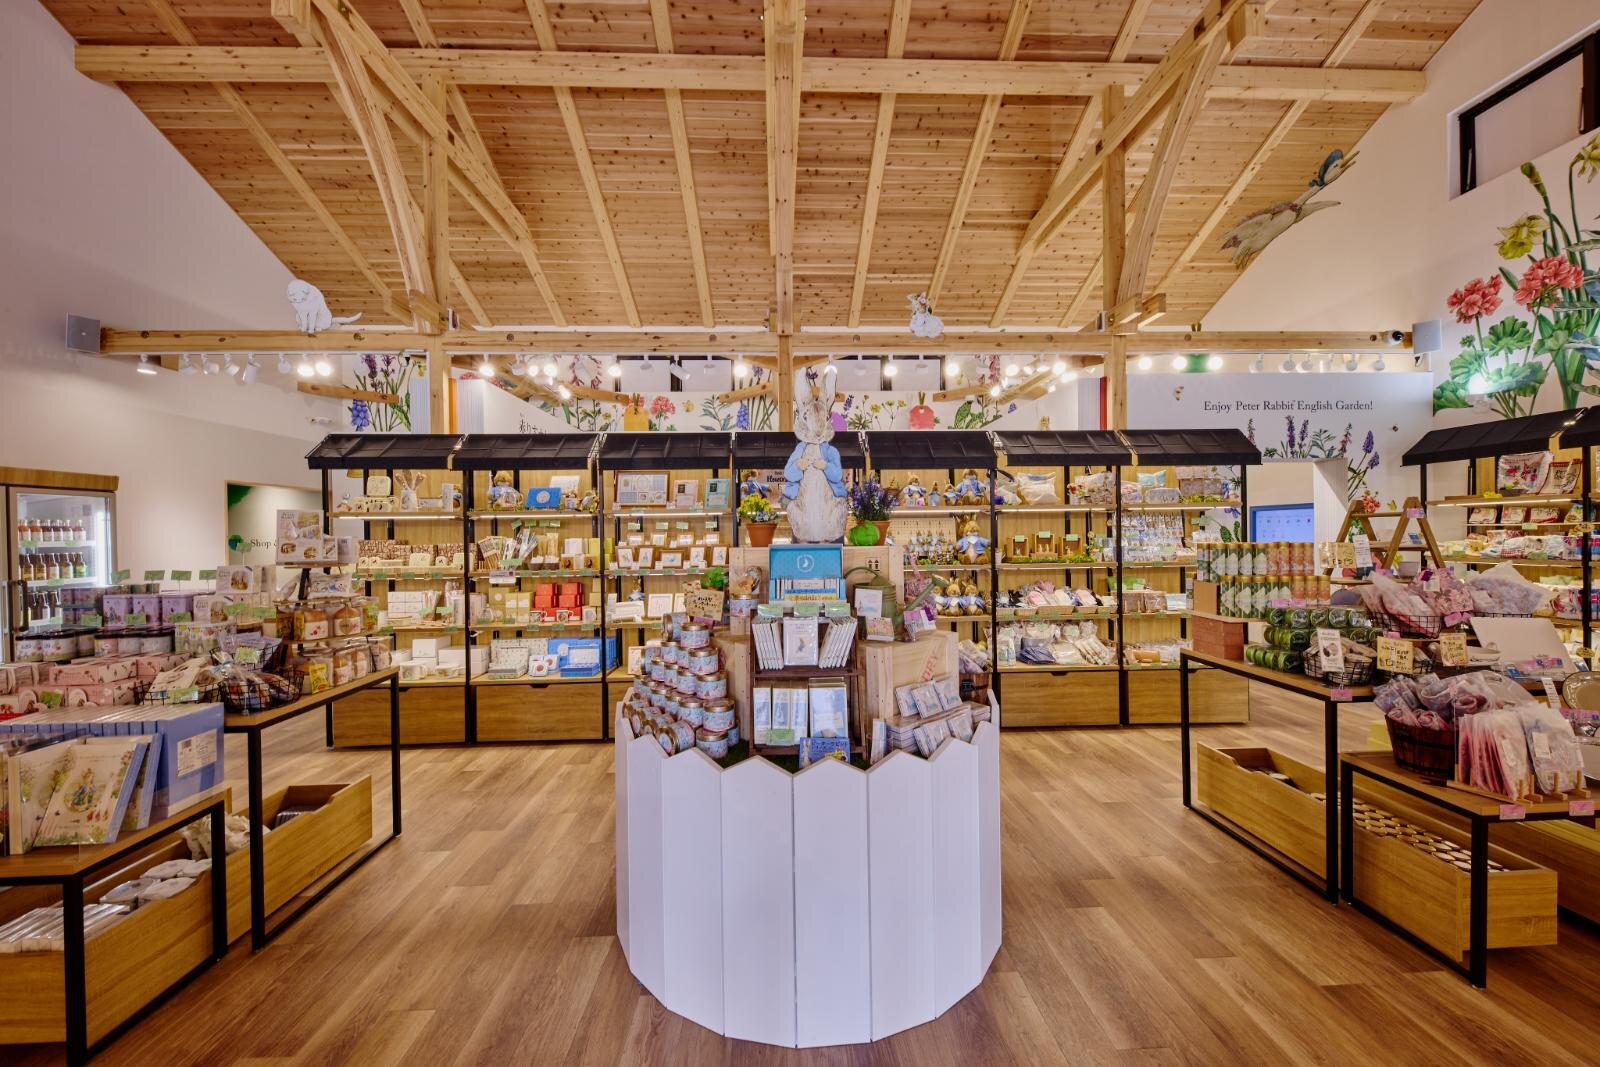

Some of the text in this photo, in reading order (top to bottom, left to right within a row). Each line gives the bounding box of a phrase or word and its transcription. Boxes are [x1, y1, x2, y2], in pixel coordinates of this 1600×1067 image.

[1204, 401, 1232, 414] Enjoy
[1236, 400, 1260, 411] Peter
[1297, 400, 1333, 414] English
[1335, 400, 1373, 411] Garden!
[250, 538, 272, 549] Shop
